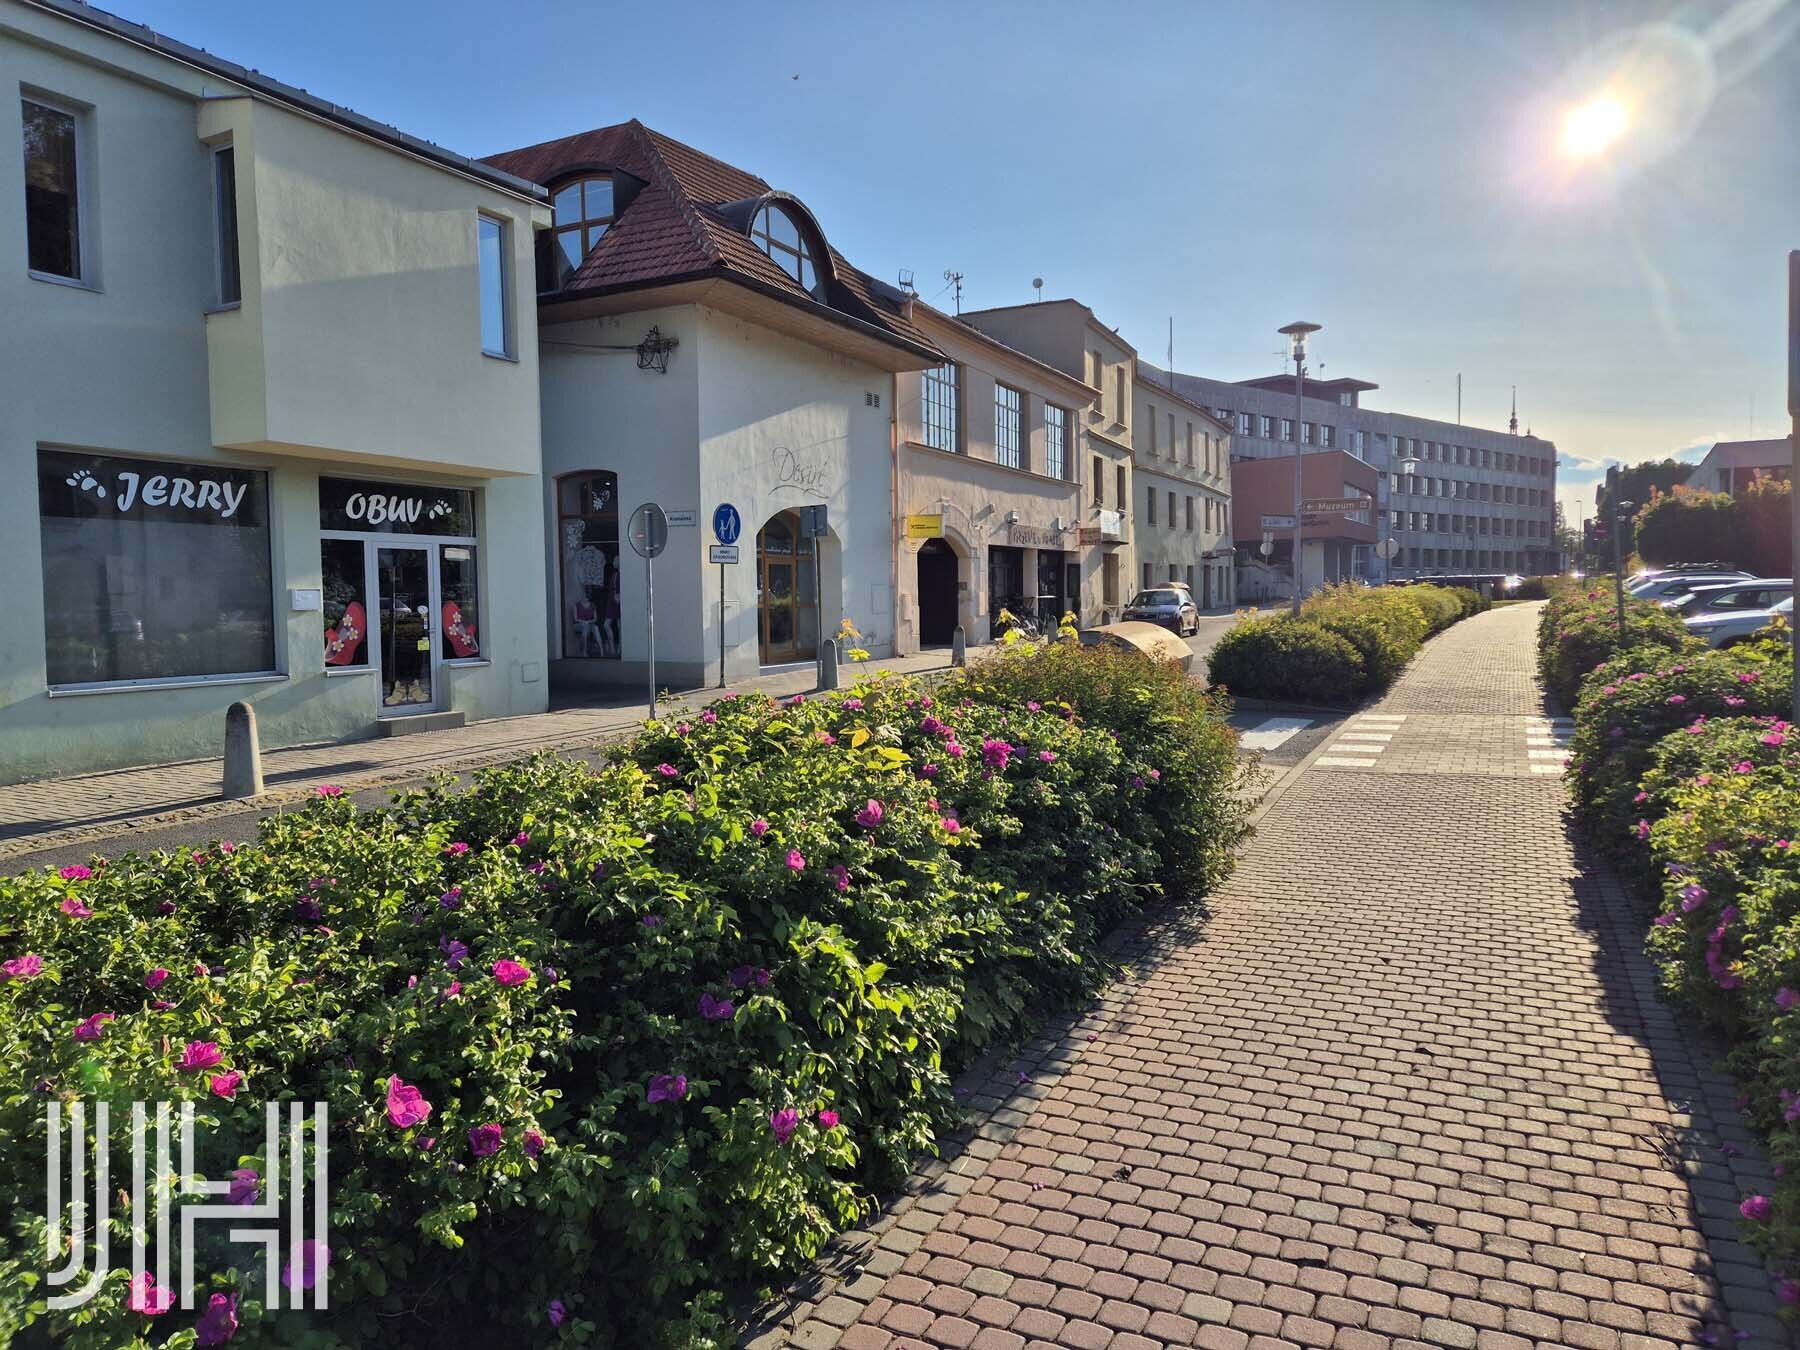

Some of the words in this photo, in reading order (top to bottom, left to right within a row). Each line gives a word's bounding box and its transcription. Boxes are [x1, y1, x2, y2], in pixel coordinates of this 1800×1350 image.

[117, 472, 248, 518] JERRY
[345, 493, 423, 525] OBUV
[1317, 502, 1355, 511] Muzeum
